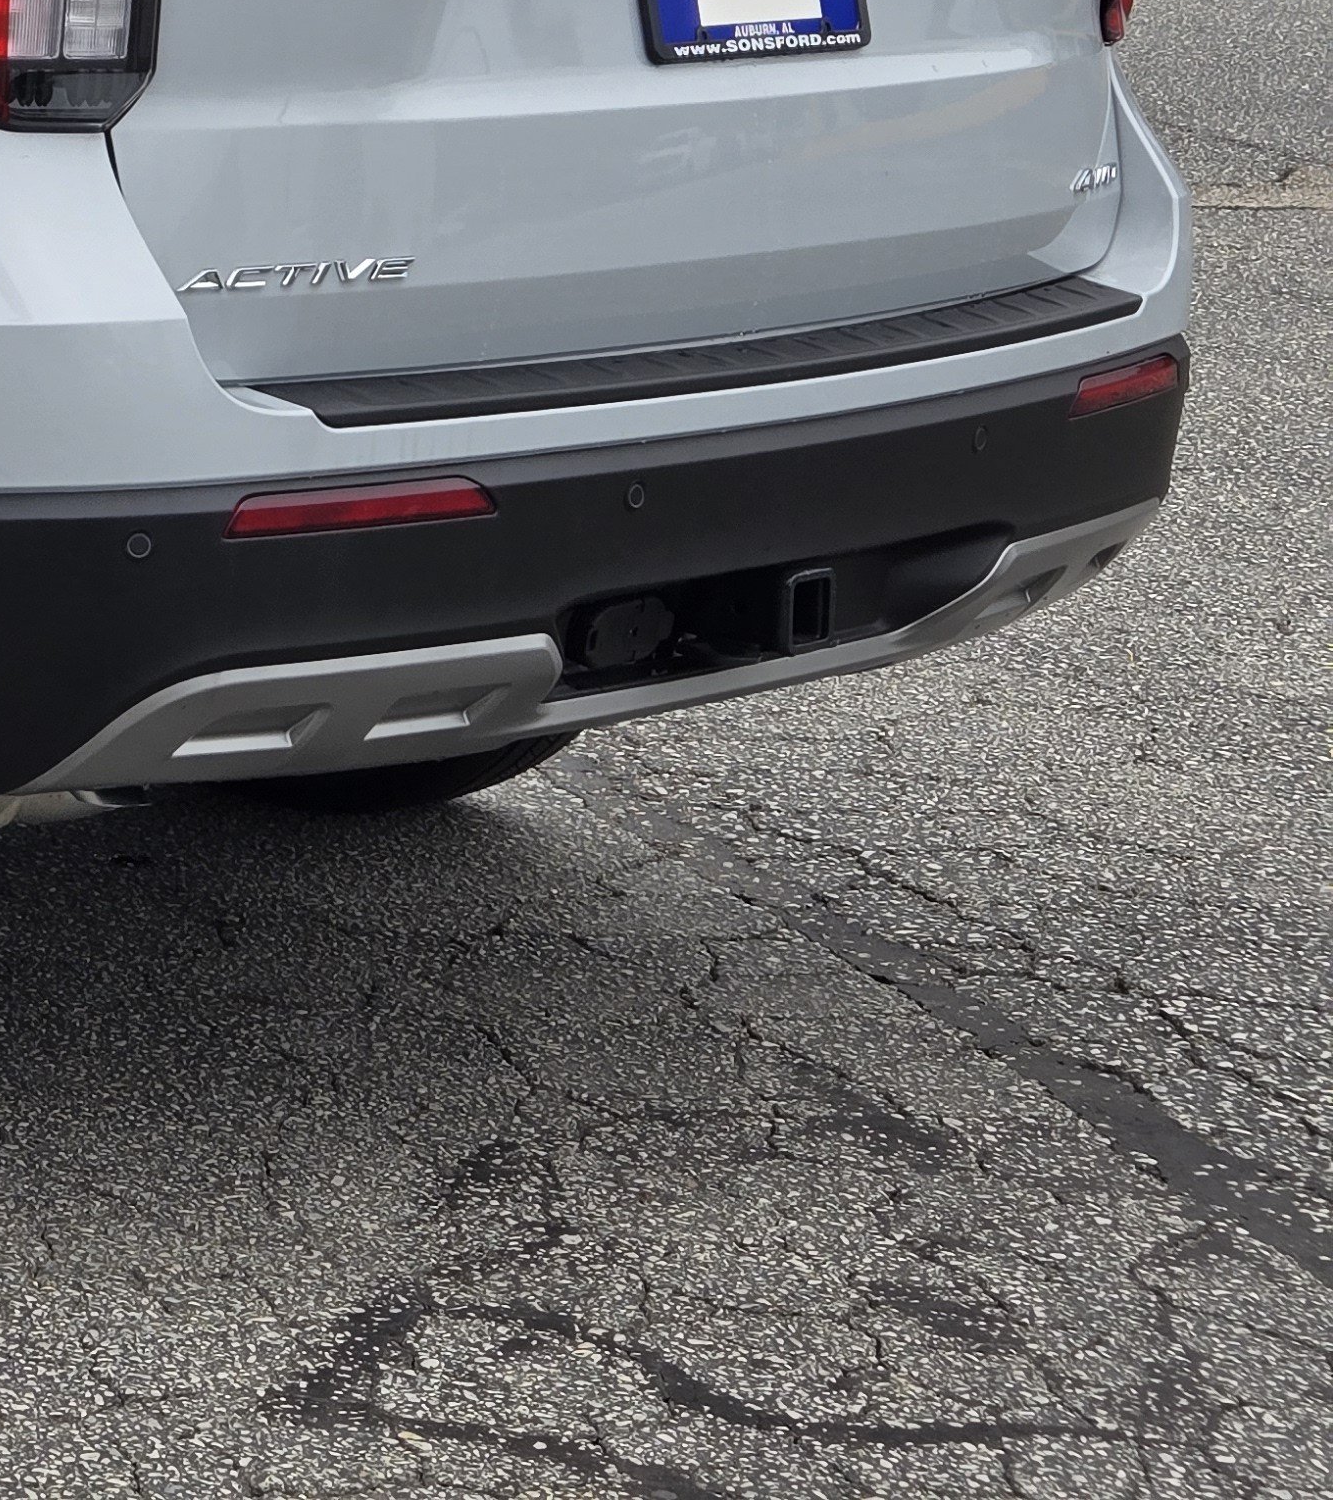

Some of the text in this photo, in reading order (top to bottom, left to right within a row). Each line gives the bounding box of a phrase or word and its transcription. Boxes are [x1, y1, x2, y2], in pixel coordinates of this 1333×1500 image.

[734, 21, 795, 37] AUBURN, AL
[673, 31, 862, 57] www.SONSFORD.com
[176, 256, 416, 293] ACTIVE
